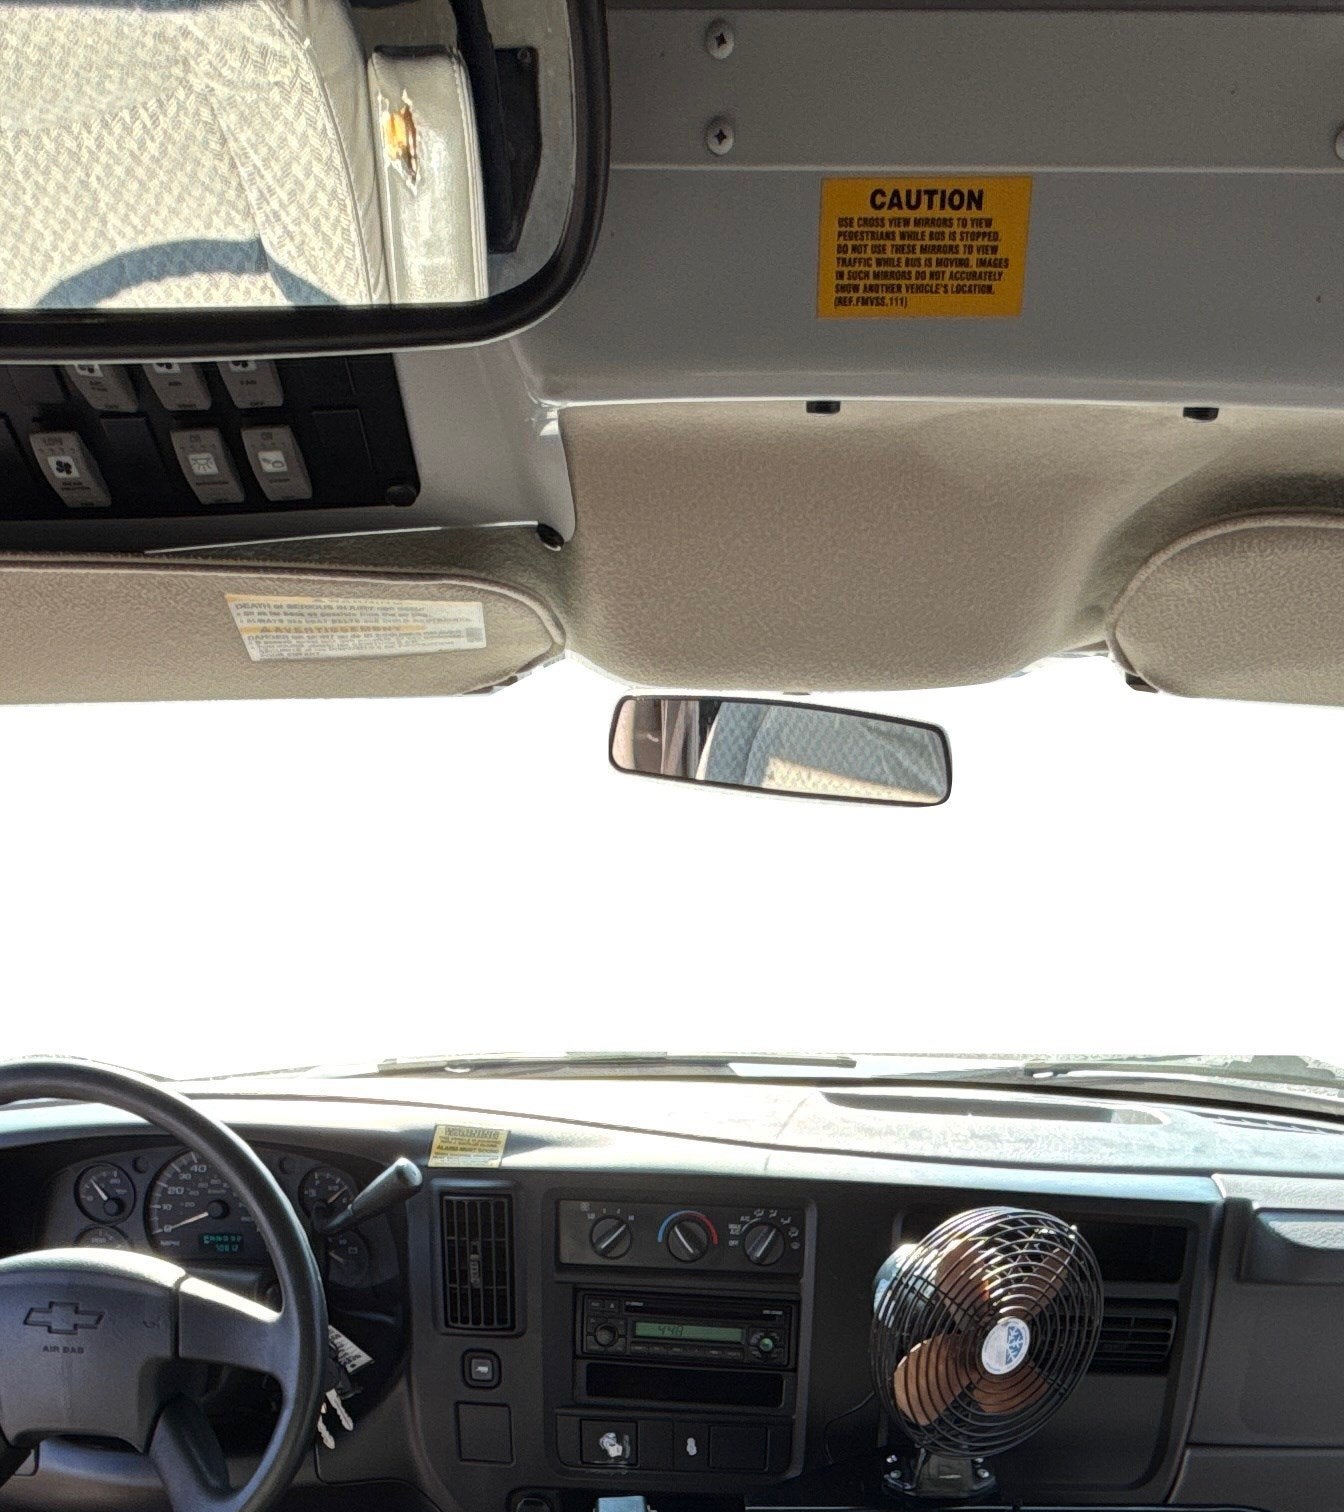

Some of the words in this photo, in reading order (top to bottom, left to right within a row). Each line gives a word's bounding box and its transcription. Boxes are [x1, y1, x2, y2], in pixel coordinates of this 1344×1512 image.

[870, 189, 984, 211] CAUTION
[838, 217, 854, 228] USE
[857, 217, 885, 228] CROSS
[889, 217, 910, 228] VIEW
[914, 217, 953, 228] MIRRORS
[957, 217, 967, 228] TO
[971, 217, 992, 228] VIEW
[837, 231, 896, 242] PEDESTRIANS
[900, 231, 926, 242] WHILE
[929, 231, 946, 242] BUS
[949, 231, 956, 242] IS
[960, 231, 1001, 242] STOPPED.
[837, 244, 848, 255] DO
[851, 244, 868, 255] NOT
[871, 244, 887, 255] USE
[891, 244, 916, 255] THESE
[920, 244, 959, 255] MIRRORS
[963, 244, 973, 255] TO
[977, 244, 998, 255] VIEW
[836, 258, 872, 268] TRAFFIC
[876, 258, 902, 268] WHILE
[905, 258, 921, 268] BUS
[924, 258, 932, 268] IS
[976, 258, 1009, 268] IMAGES
[836, 271, 844, 281] IN
[847, 271, 869, 281] SUCH
[873, 271, 912, 281] MIRRORS
[915, 271, 926, 281] DO
[929, 271, 945, 281] NOT
[949, 271, 1003, 281] ACCURATELY
[835, 284, 859, 295] SHOW
[863, 284, 902, 295] ANOTHER
